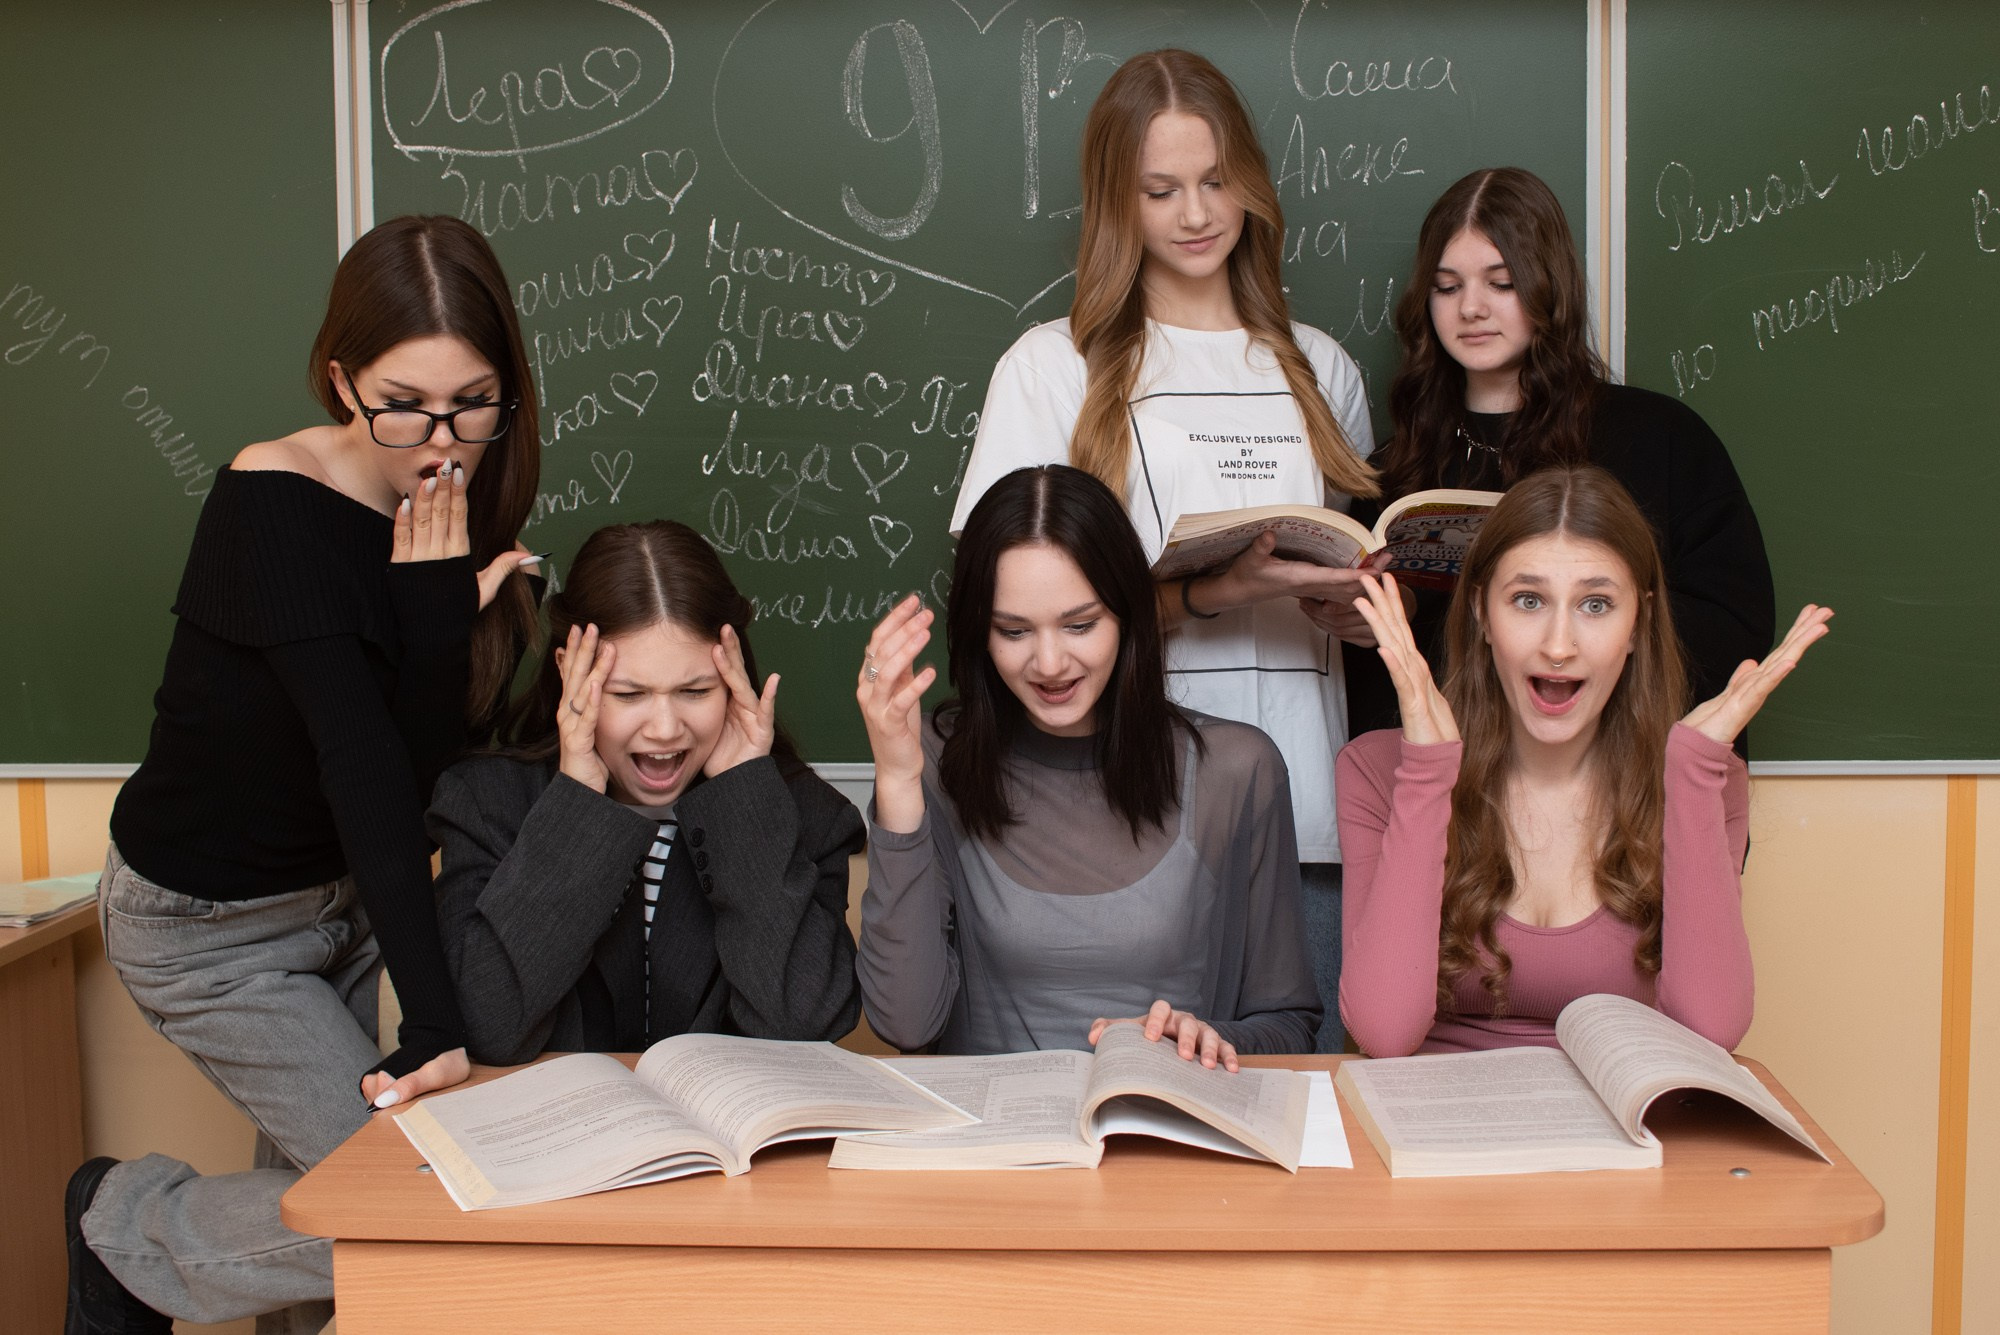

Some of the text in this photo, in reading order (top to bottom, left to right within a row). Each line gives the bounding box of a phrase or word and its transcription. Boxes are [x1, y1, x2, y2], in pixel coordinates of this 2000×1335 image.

[1290, 0, 1457, 101] Саша
[411, 31, 602, 174] Лера
[841, 19, 943, 241] 9
[706, 216, 853, 293] Настя
[533, 308, 649, 408] рина
[708, 274, 824, 362] Ира
[692, 338, 864, 411] Диана
[702, 409, 843, 534] Лиза
[1189, 433, 1302, 444] EXCLUSIVELY DESIGNED
[1218, 460, 1278, 469] LAND ROVER
[1241, 448, 1254, 457] BY
